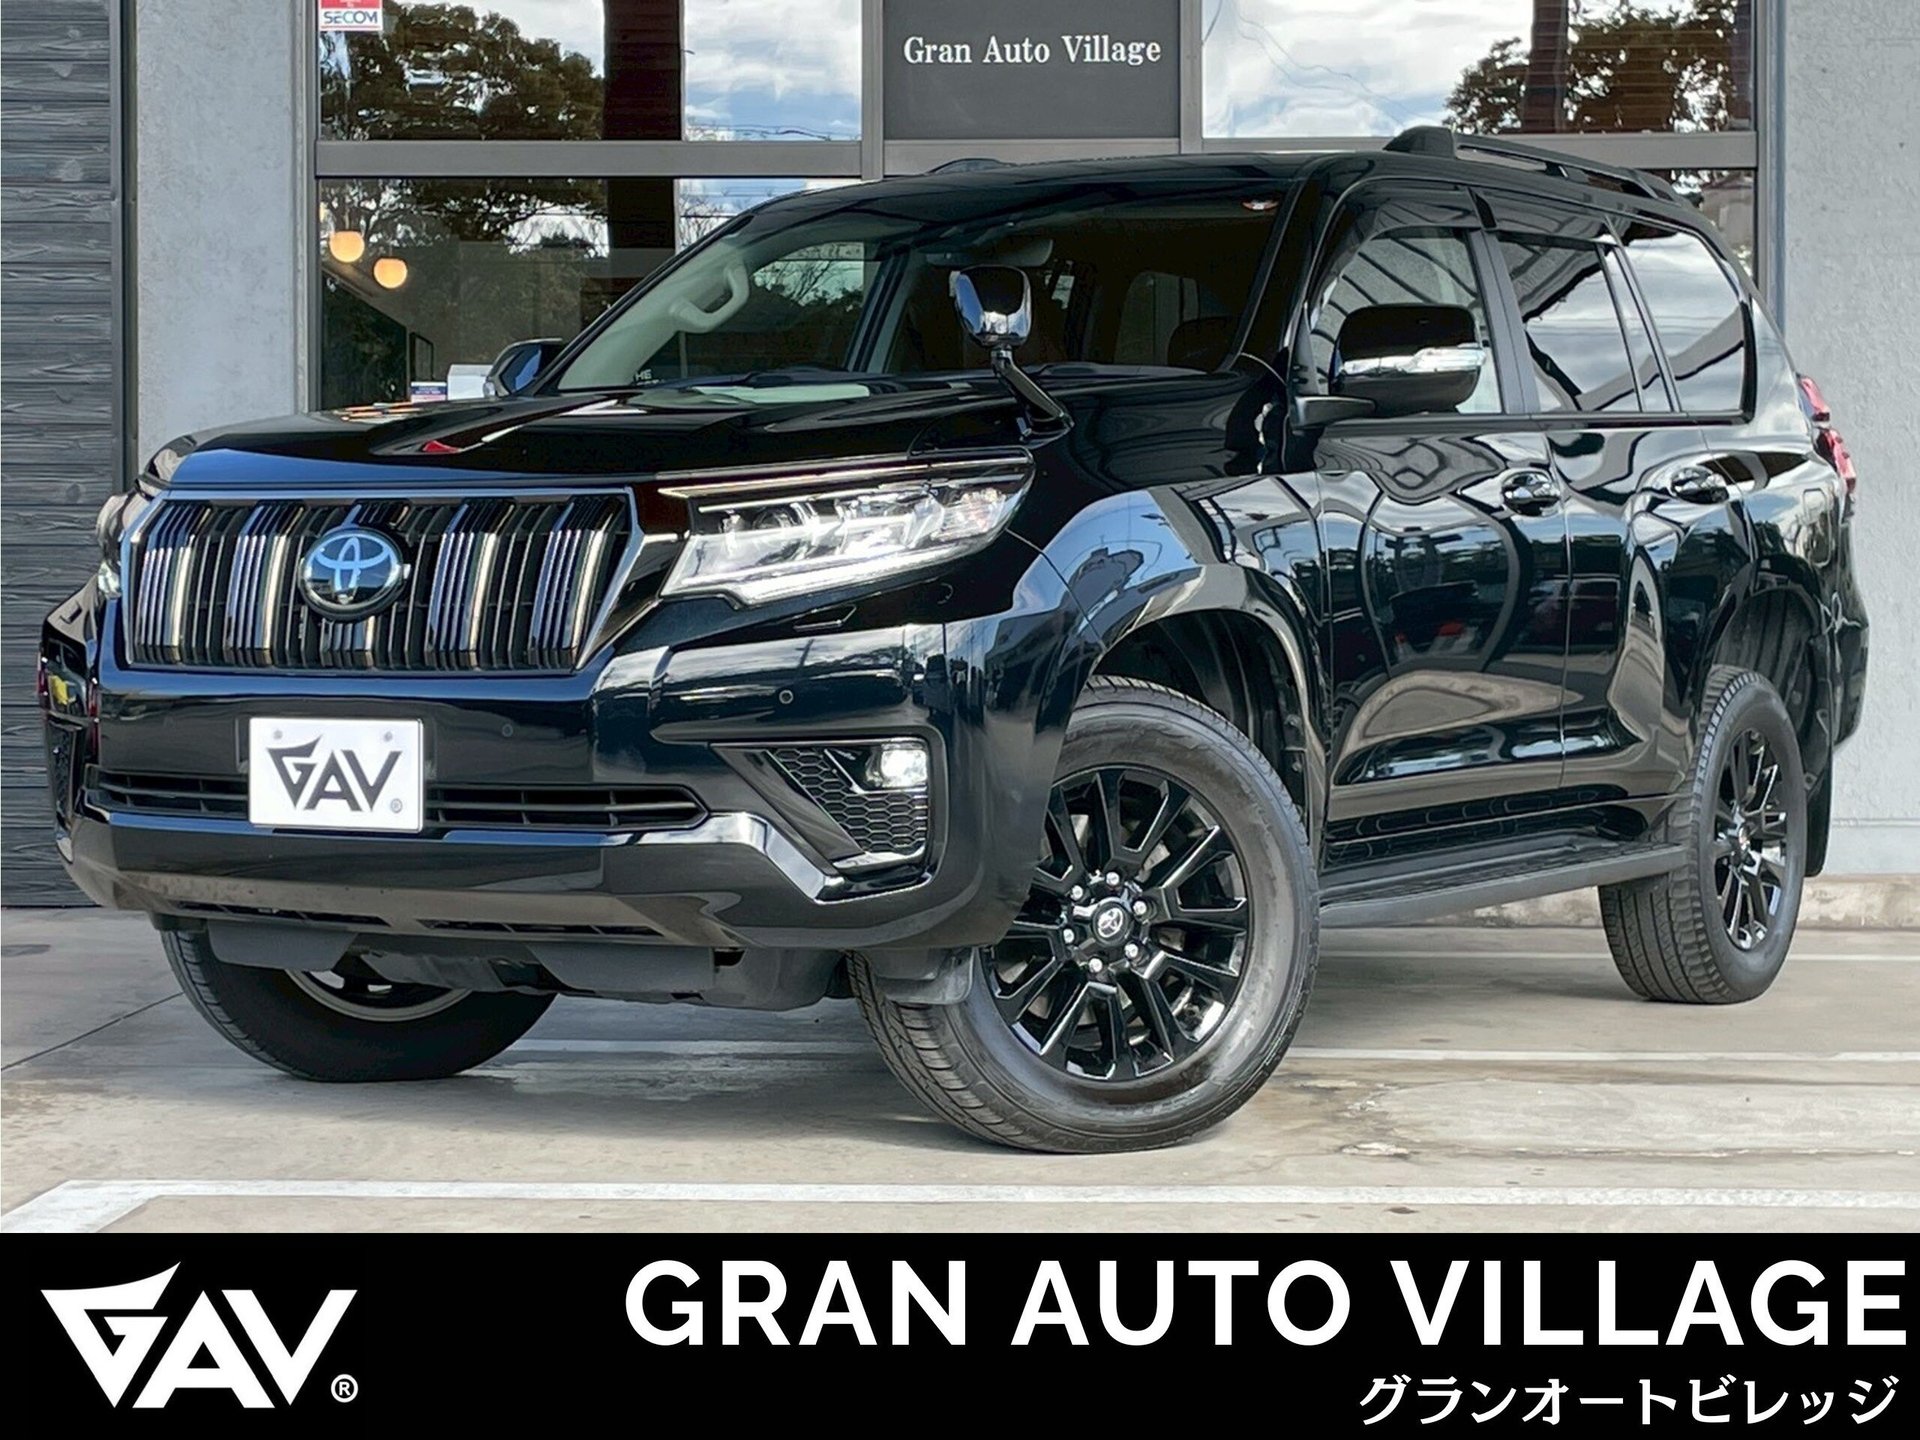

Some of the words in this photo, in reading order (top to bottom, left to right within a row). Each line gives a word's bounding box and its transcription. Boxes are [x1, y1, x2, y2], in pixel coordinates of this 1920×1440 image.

[323, 10, 378, 24] SECOM
[903, 36, 973, 64] Gran
[982, 35, 1051, 63] Auto
[1061, 34, 1162, 66] Village
